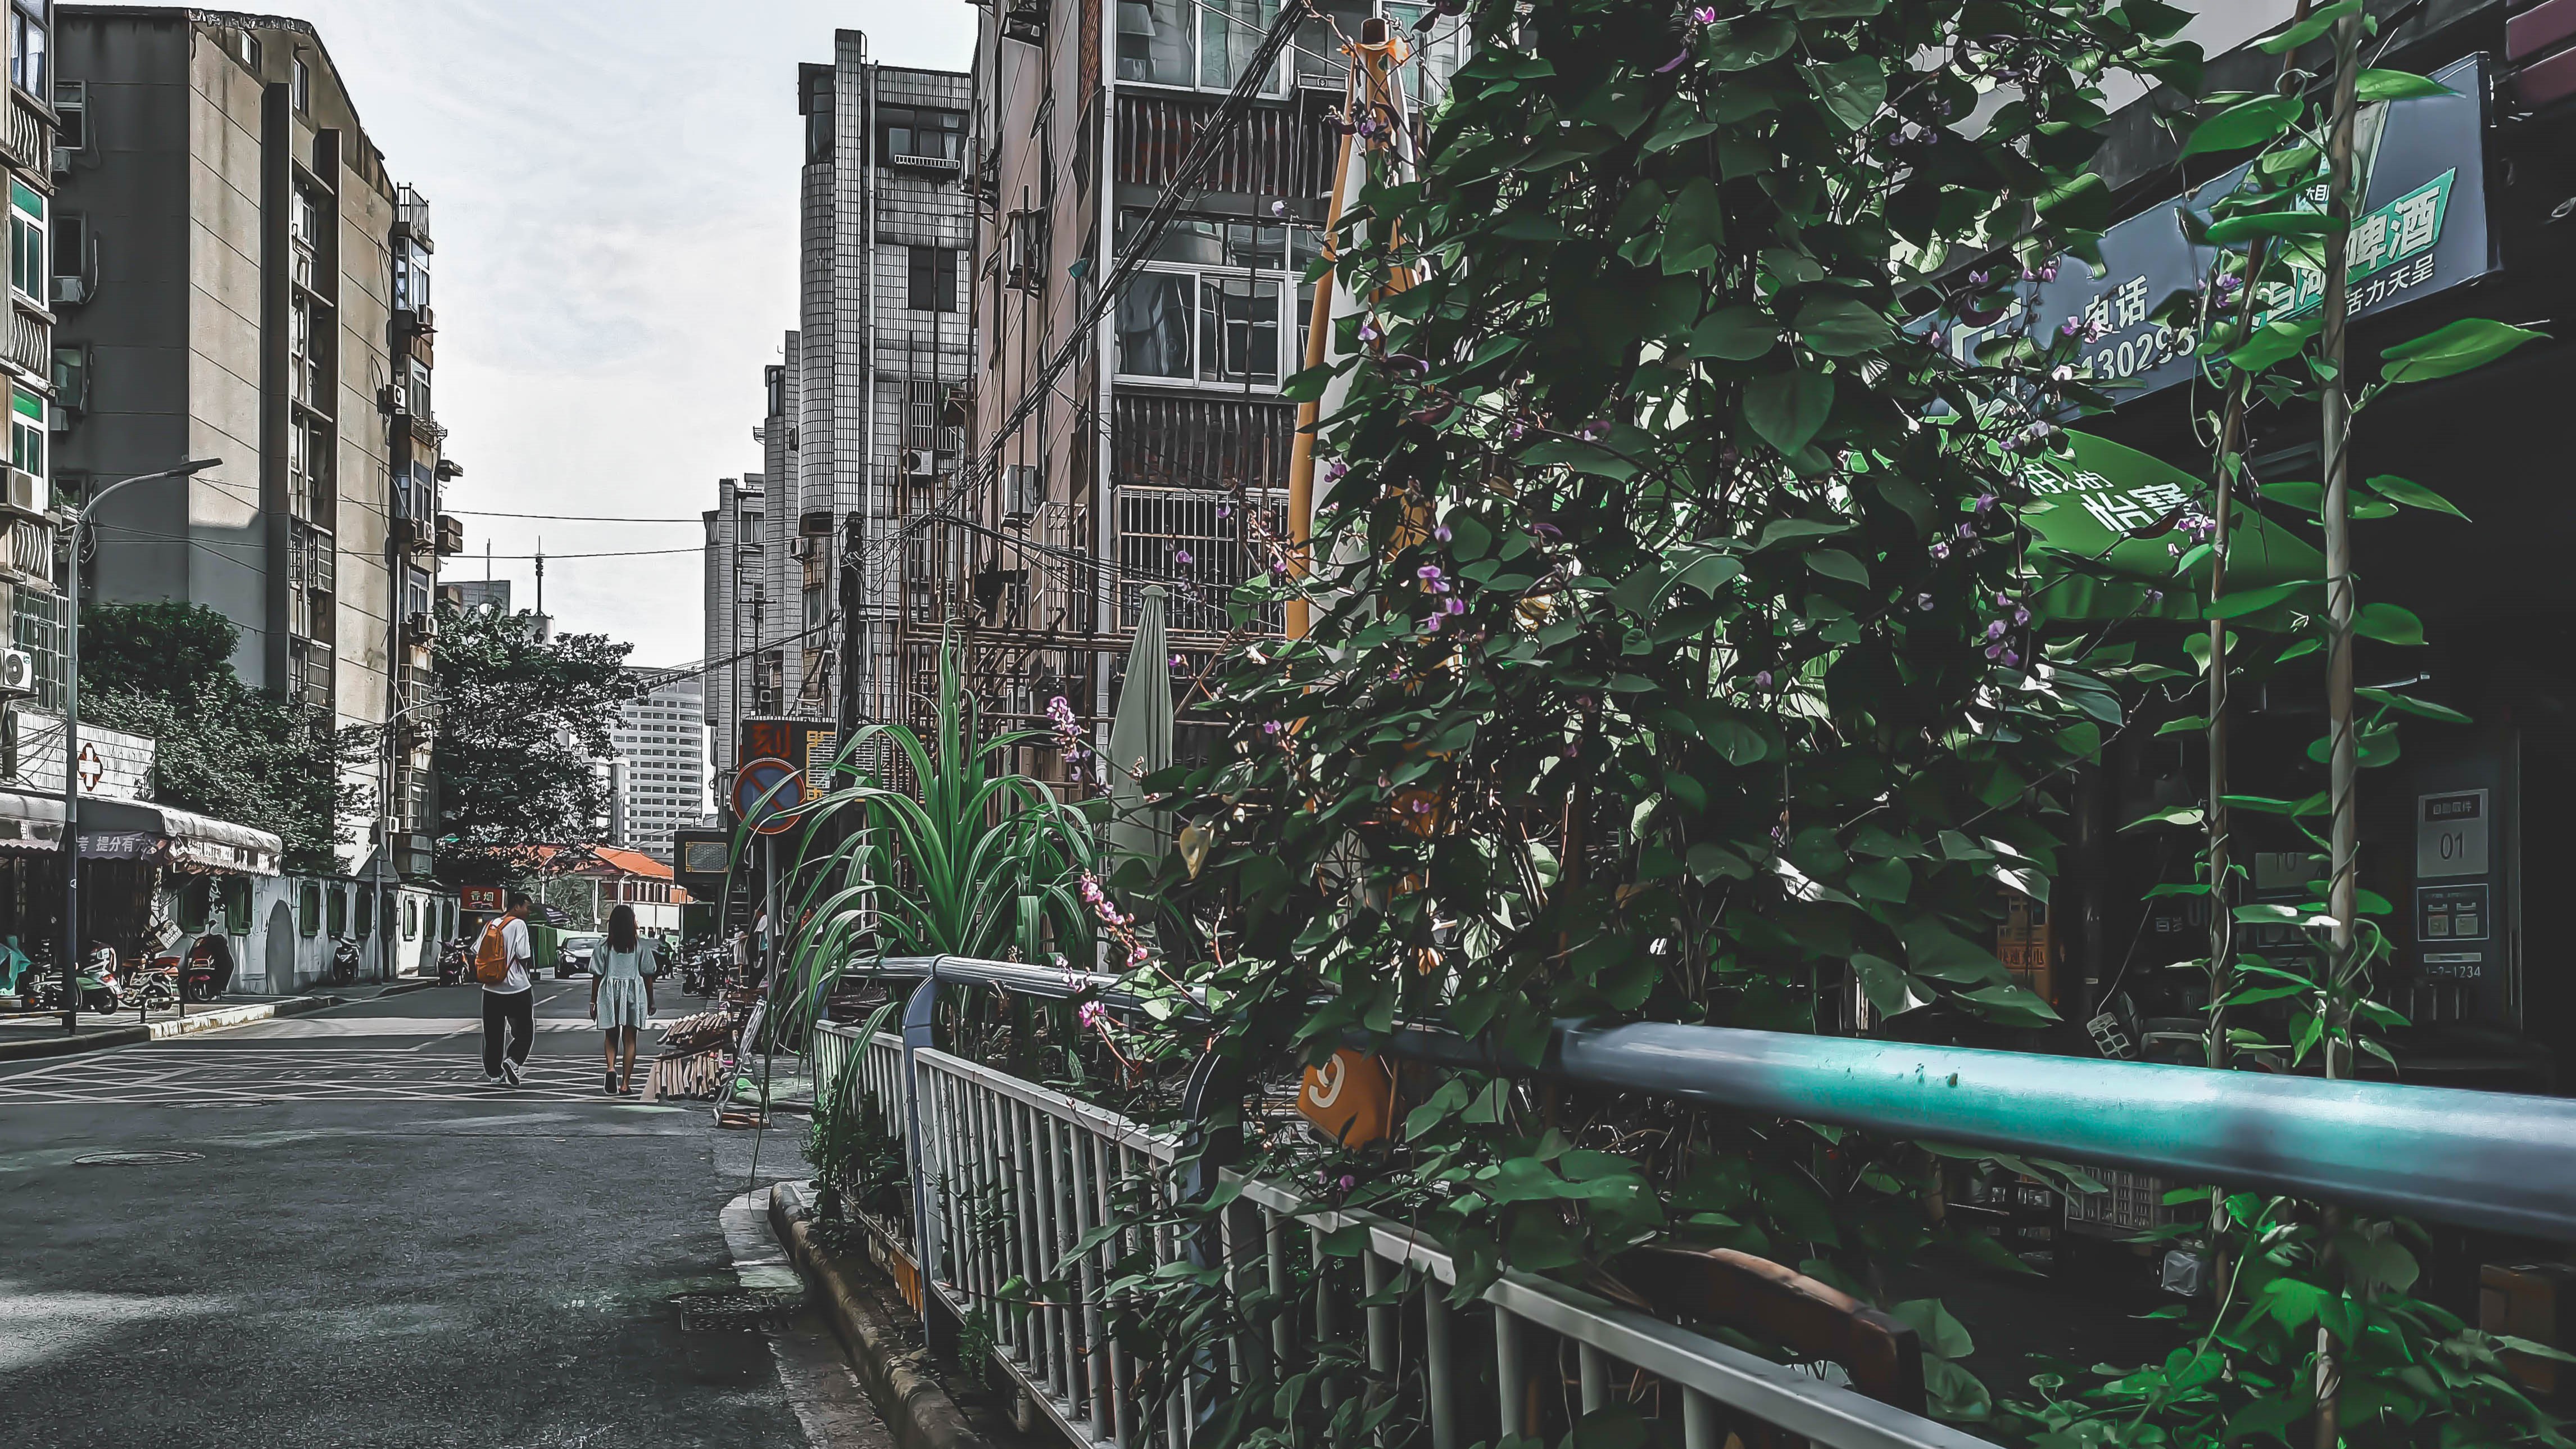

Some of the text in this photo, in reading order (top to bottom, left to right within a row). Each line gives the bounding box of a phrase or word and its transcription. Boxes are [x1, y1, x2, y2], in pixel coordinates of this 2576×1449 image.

[2084, 275, 2147, 335] 电话
[2346, 253, 2434, 316] 活力天呈
[2440, 832, 2464, 860] 01
